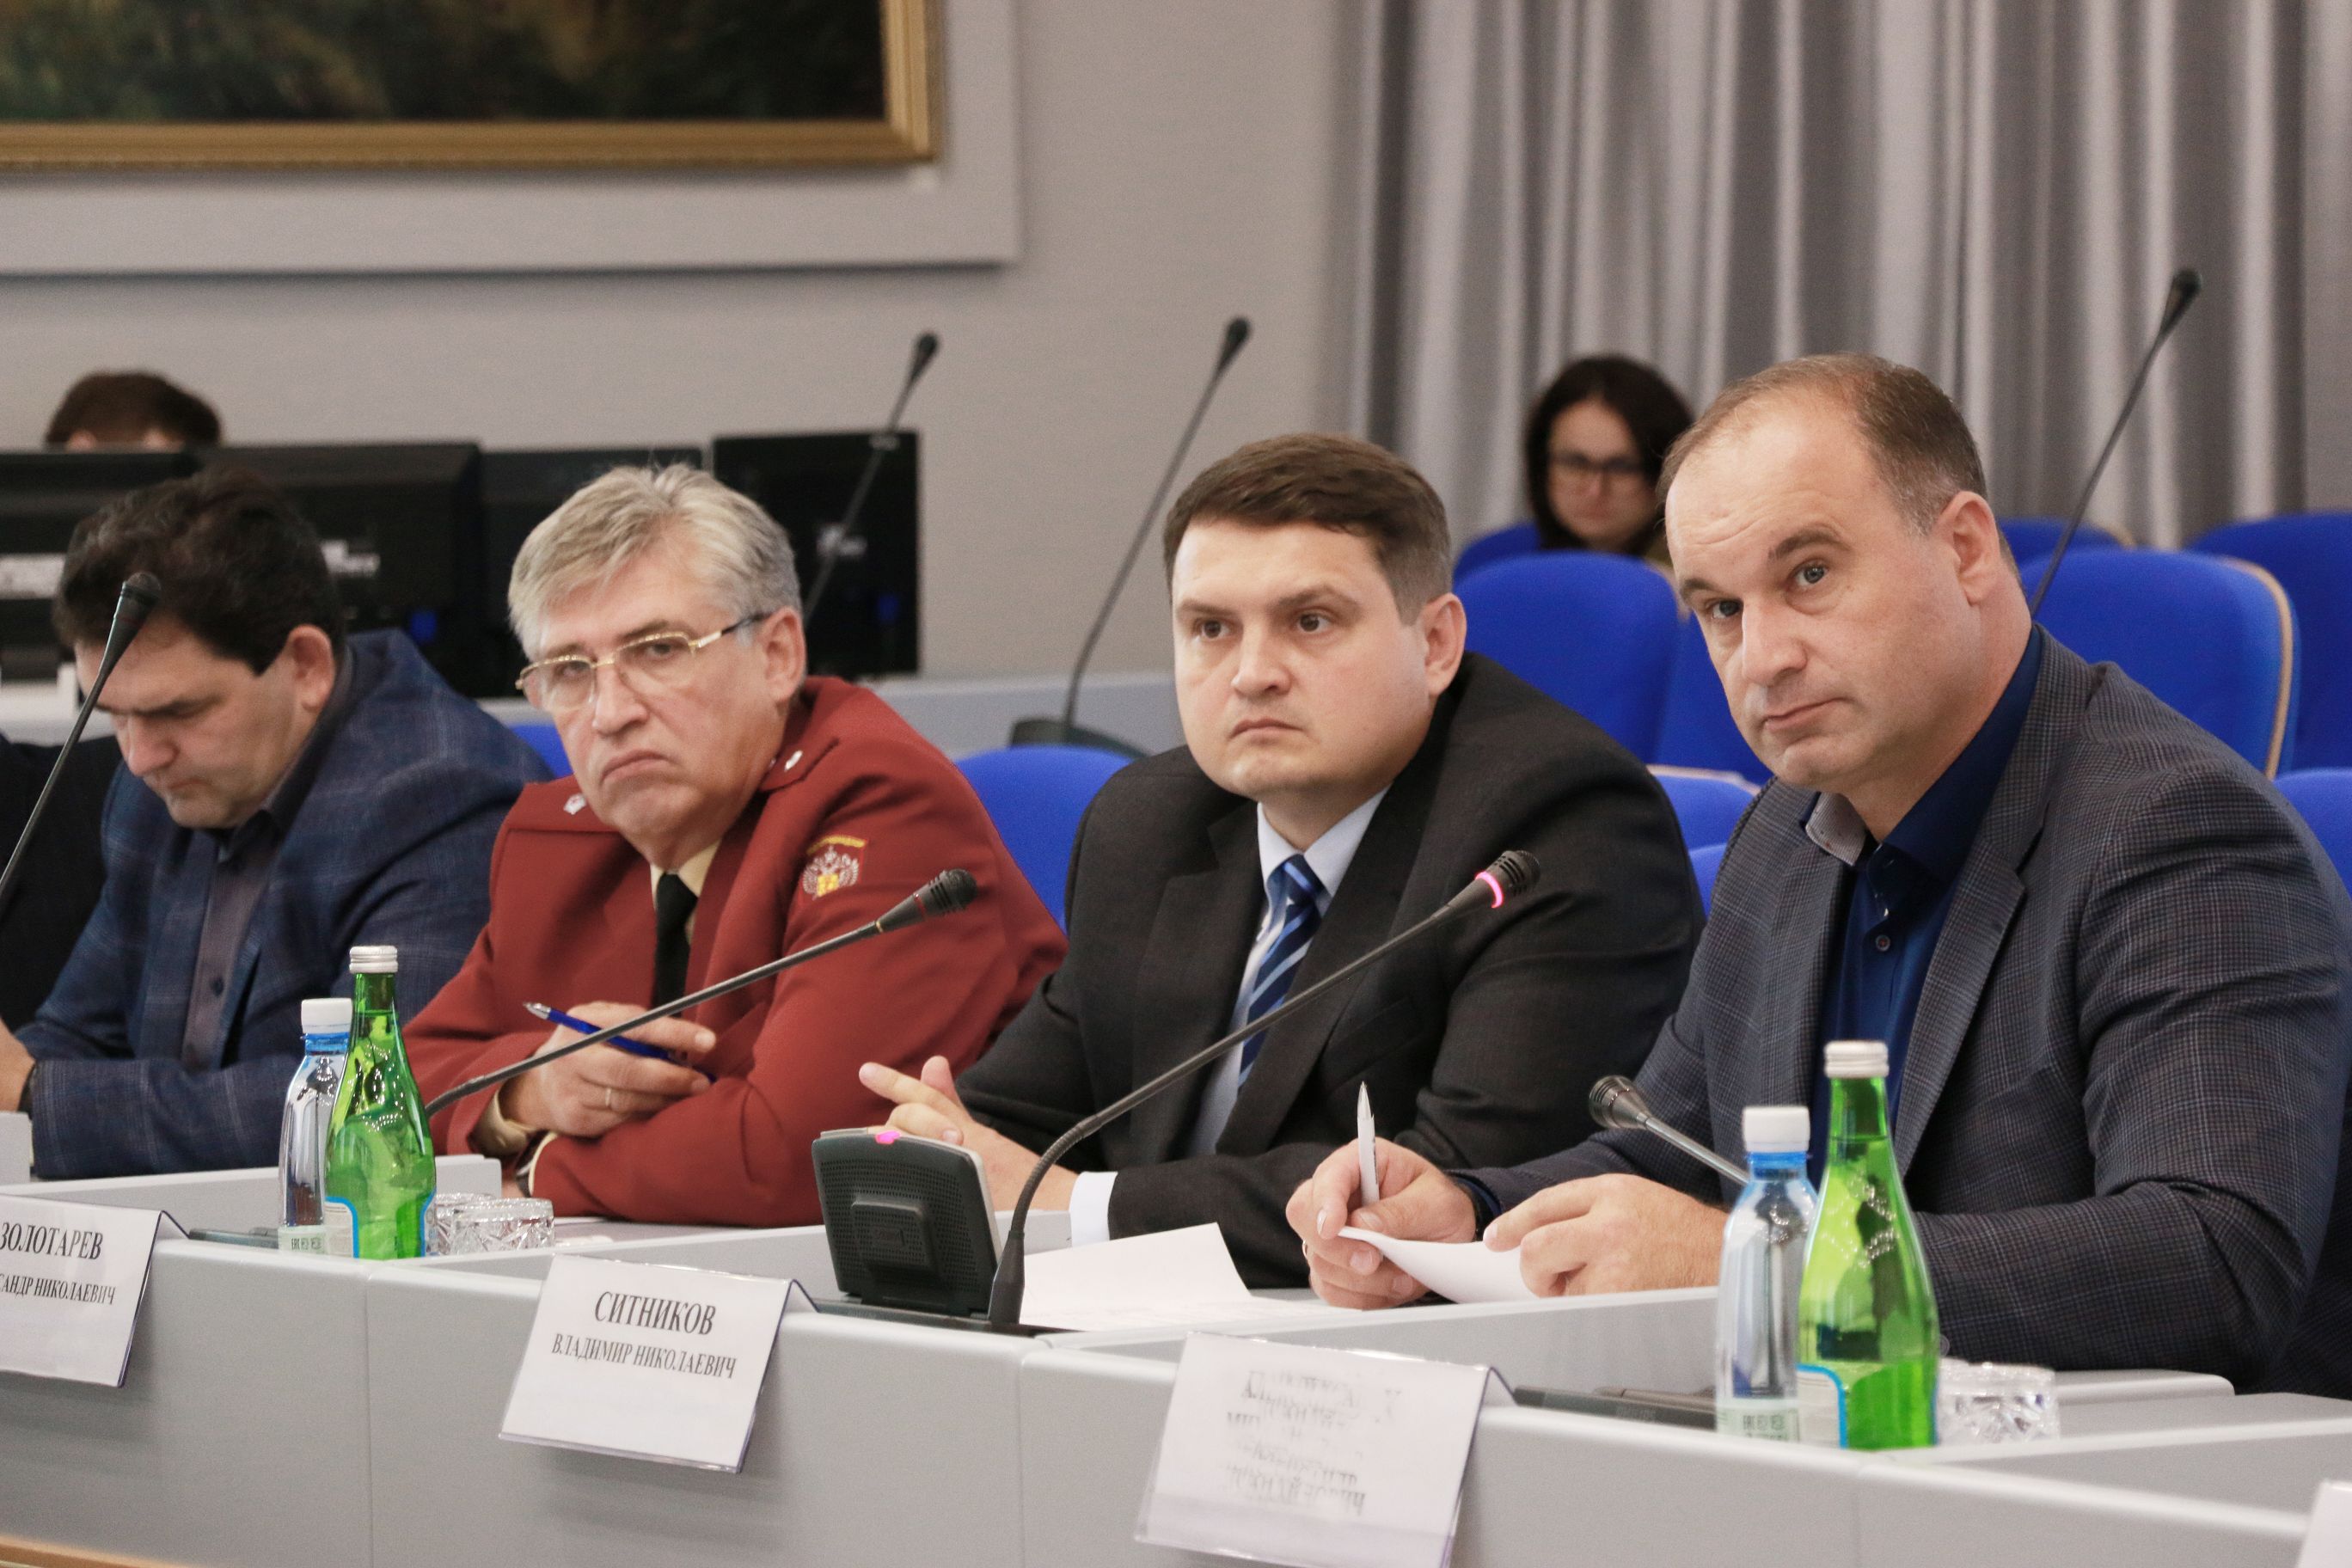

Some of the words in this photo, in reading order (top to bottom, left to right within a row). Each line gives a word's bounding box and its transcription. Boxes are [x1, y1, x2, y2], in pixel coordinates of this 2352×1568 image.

[0, 1222, 104, 1260] ЗОЛОТАРЕВ
[34, 1277, 116, 1305] НИКОЛАЕВИЧ
[595, 1291, 717, 1335] СИТНИКОВ
[552, 1333, 633, 1363] ВЛАДИМИР
[633, 1345, 738, 1379] НИКОЛАЕВИЧ
